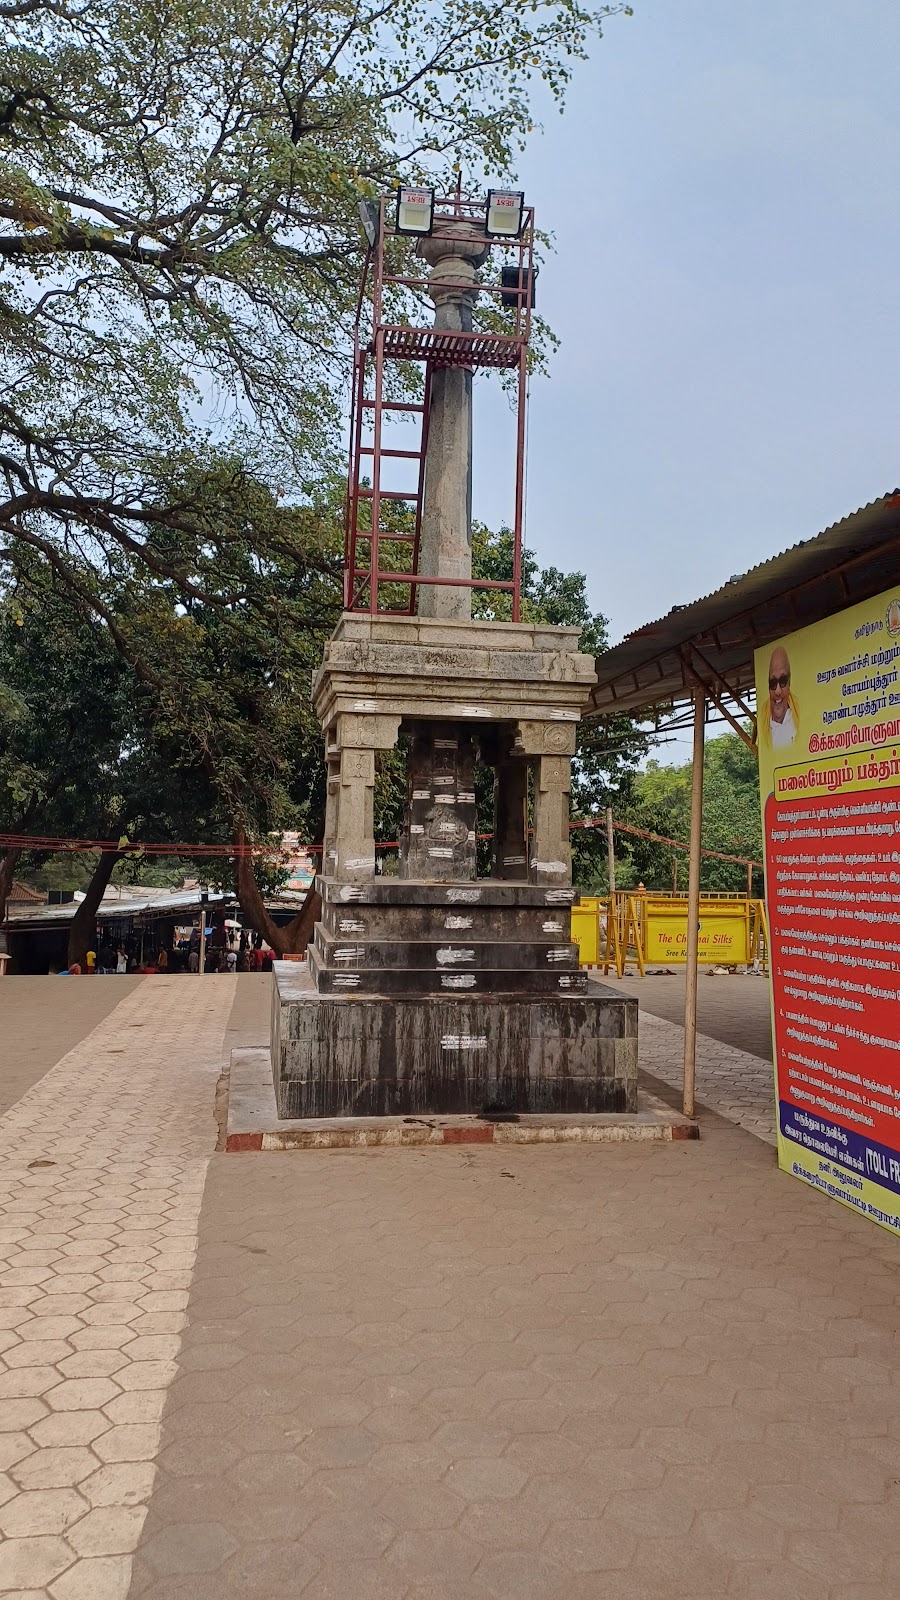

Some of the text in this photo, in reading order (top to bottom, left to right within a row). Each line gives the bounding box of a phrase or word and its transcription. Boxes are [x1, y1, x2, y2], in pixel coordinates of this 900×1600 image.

[817, 668, 836, 684] ஊரக
[838, 653, 870, 676] வளர்ச்சி
[842, 665, 898, 696] கோயம்புத்தூர்
[823, 690, 887, 725] தொண்டாமுத்தூர்
[808, 719, 900, 753] இக்கரைபோளுவா
[778, 749, 900, 791] மலையேறும் பக்தர்
[658, 933, 733, 944] The Chnai Silks
[665, 949, 679, 957] Sree
[794, 1111, 820, 1131] மருத்துவ
[889, 1157, 900, 1185] FR
